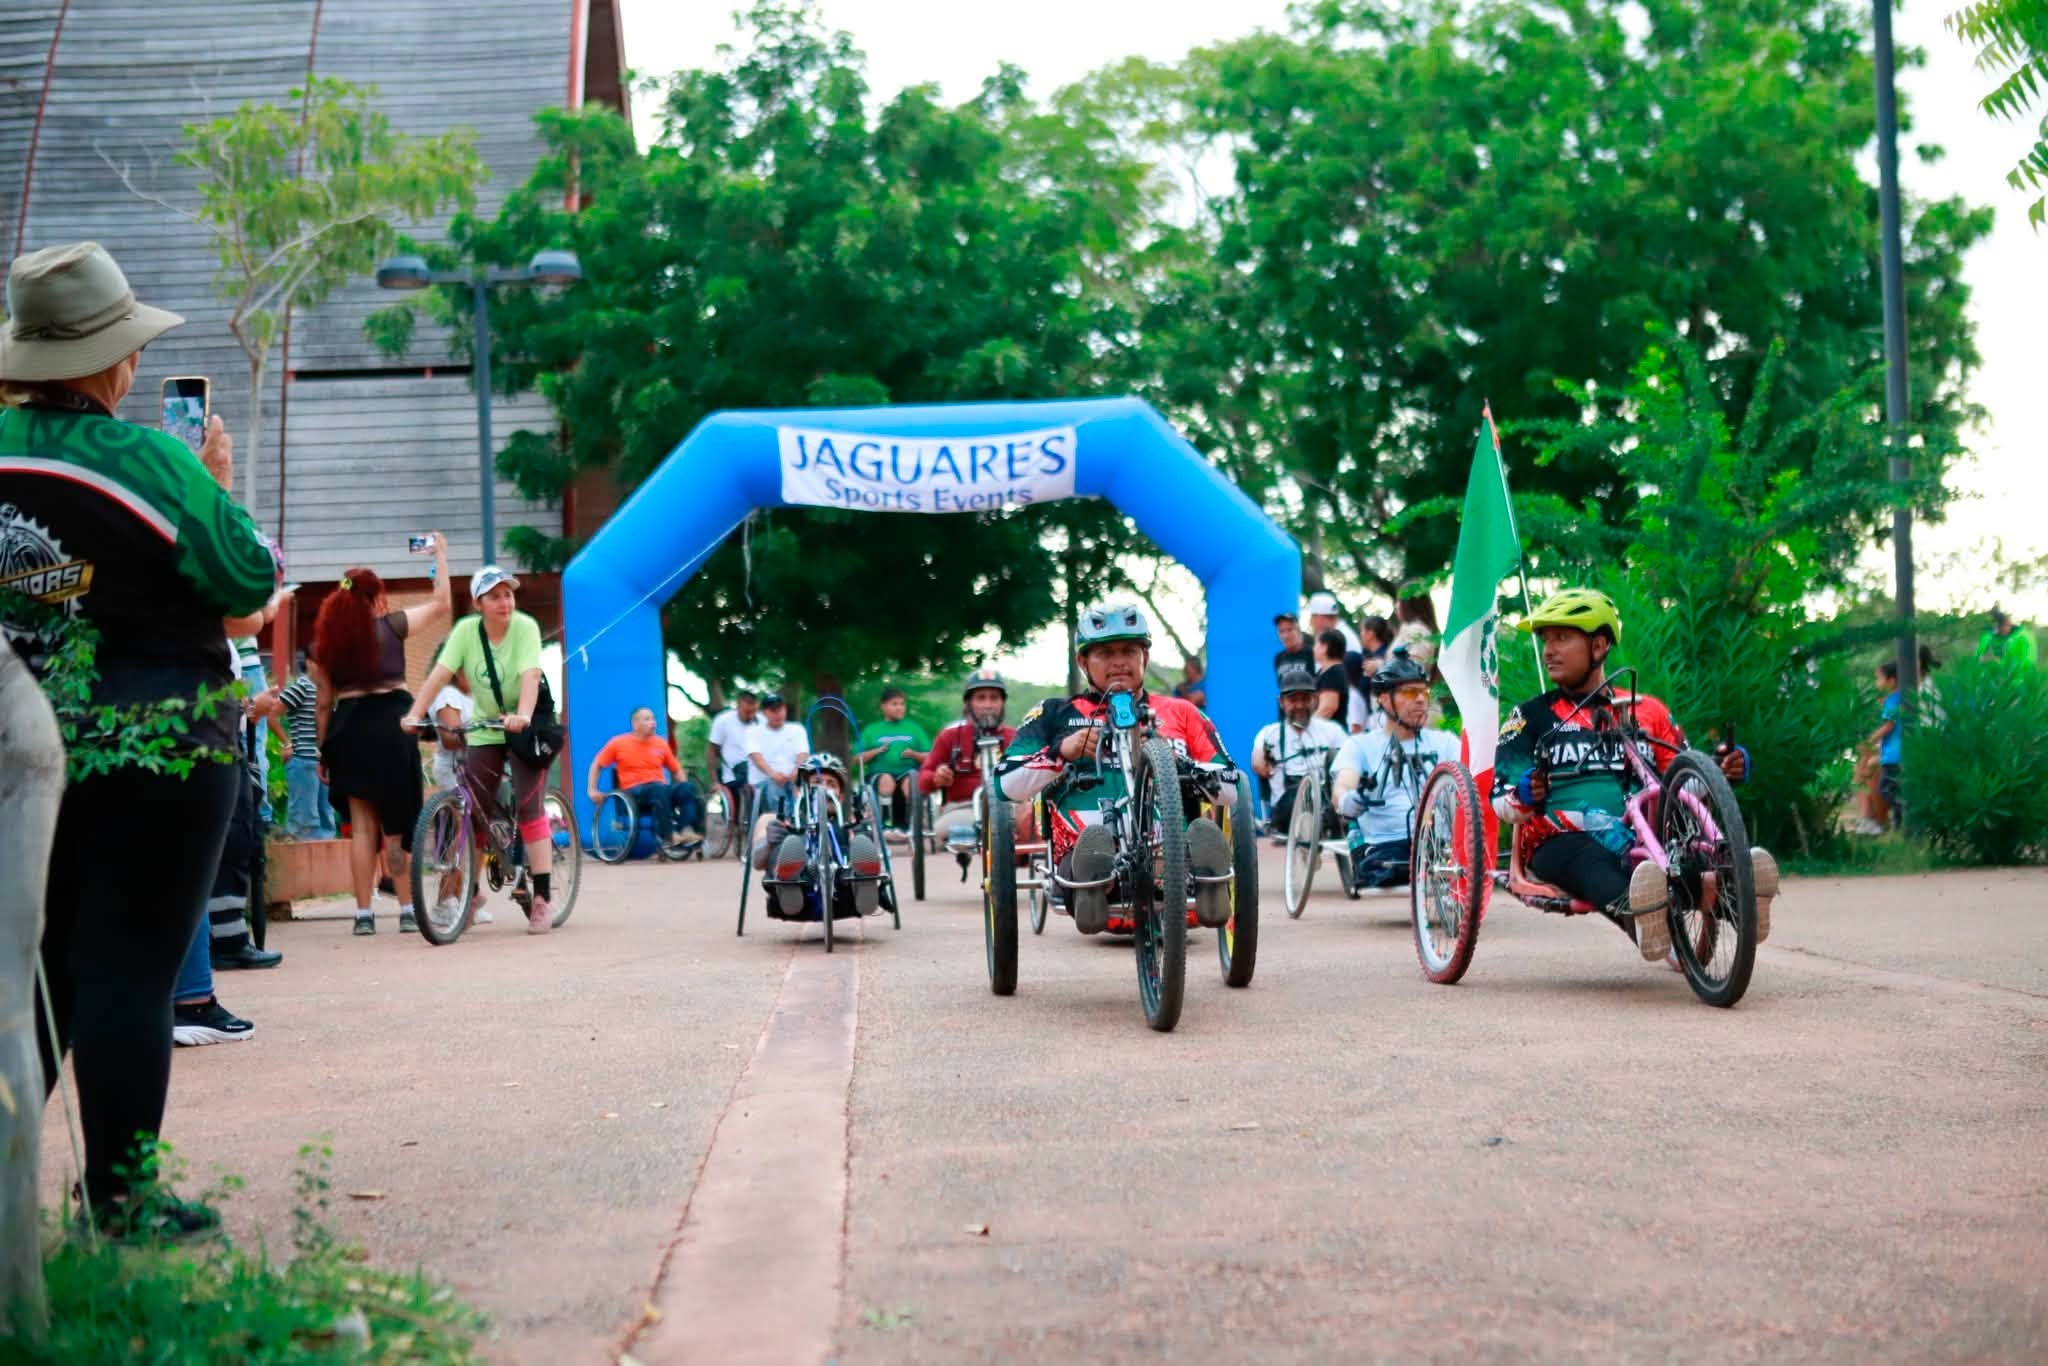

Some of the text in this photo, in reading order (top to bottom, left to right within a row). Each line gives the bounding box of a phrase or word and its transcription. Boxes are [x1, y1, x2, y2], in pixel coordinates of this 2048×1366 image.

[791, 434, 1067, 485] JAGUARES
[825, 477, 1033, 511] Sports Events
